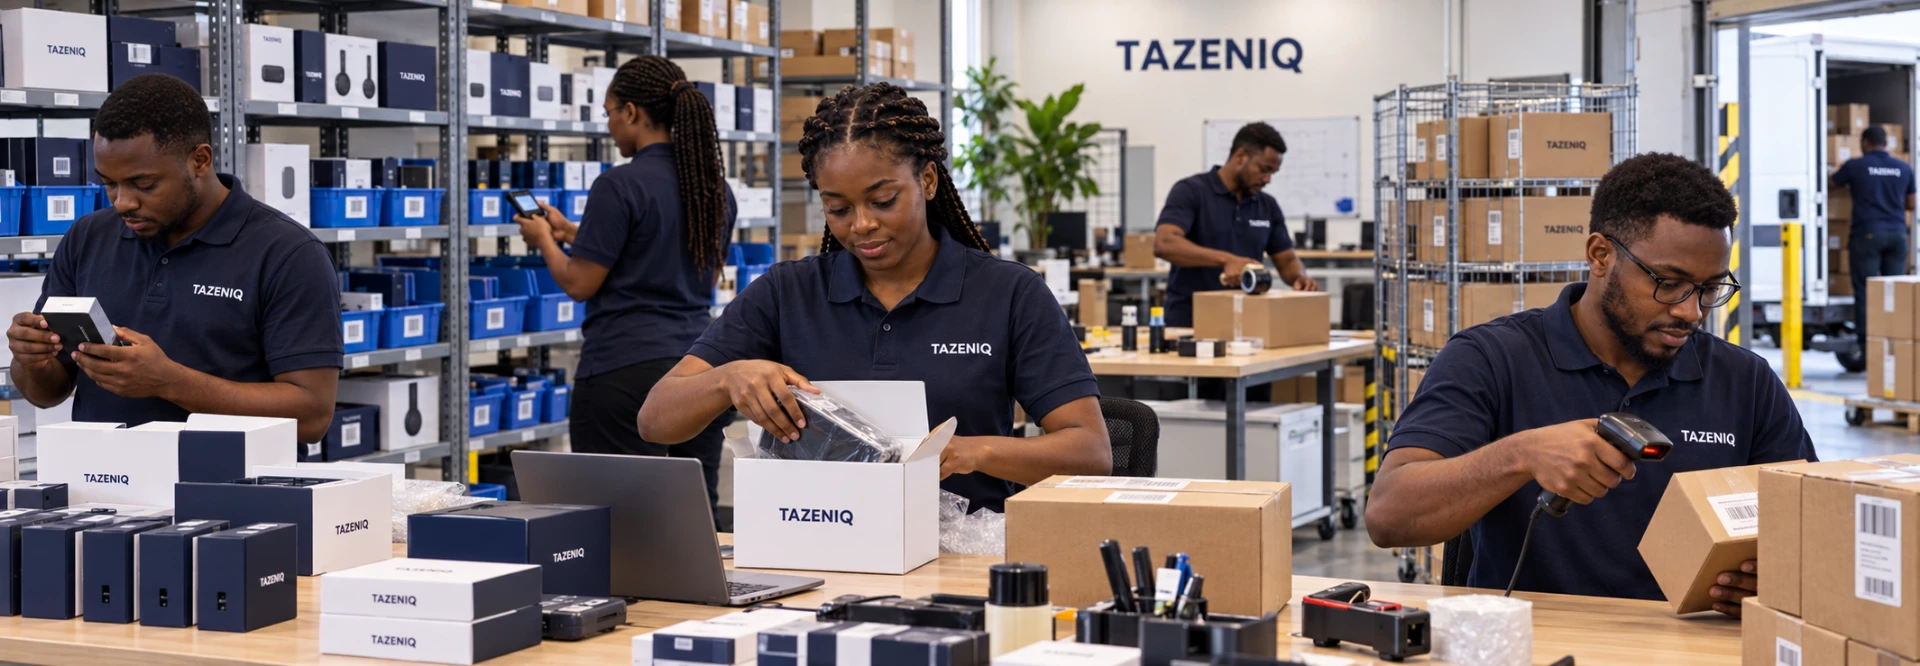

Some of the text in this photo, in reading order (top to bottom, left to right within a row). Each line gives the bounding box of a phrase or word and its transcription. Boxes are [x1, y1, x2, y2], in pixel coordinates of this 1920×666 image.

[47, 45, 86, 58] TAZENIQ
[1116, 38, 1304, 74] TAZENIQ
[400, 72, 426, 82] TAZENIQ
[1546, 140, 1587, 151] TAZENIQ
[1543, 224, 1584, 236] TAZENIQ
[192, 284, 244, 302] TAZENIQ
[930, 343, 993, 357] TAZENIQ
[1680, 430, 1736, 447] TAZENIQ
[83, 473, 130, 486] TAZENIQ
[779, 507, 854, 526] TAZENIQ
[335, 518, 369, 535] TAZENIQ
[553, 547, 585, 563] TAZENIQ
[260, 571, 285, 587] TAZENIQ
[372, 593, 417, 607] TAZENIQ
[371, 634, 417, 649] TAZENIQ
